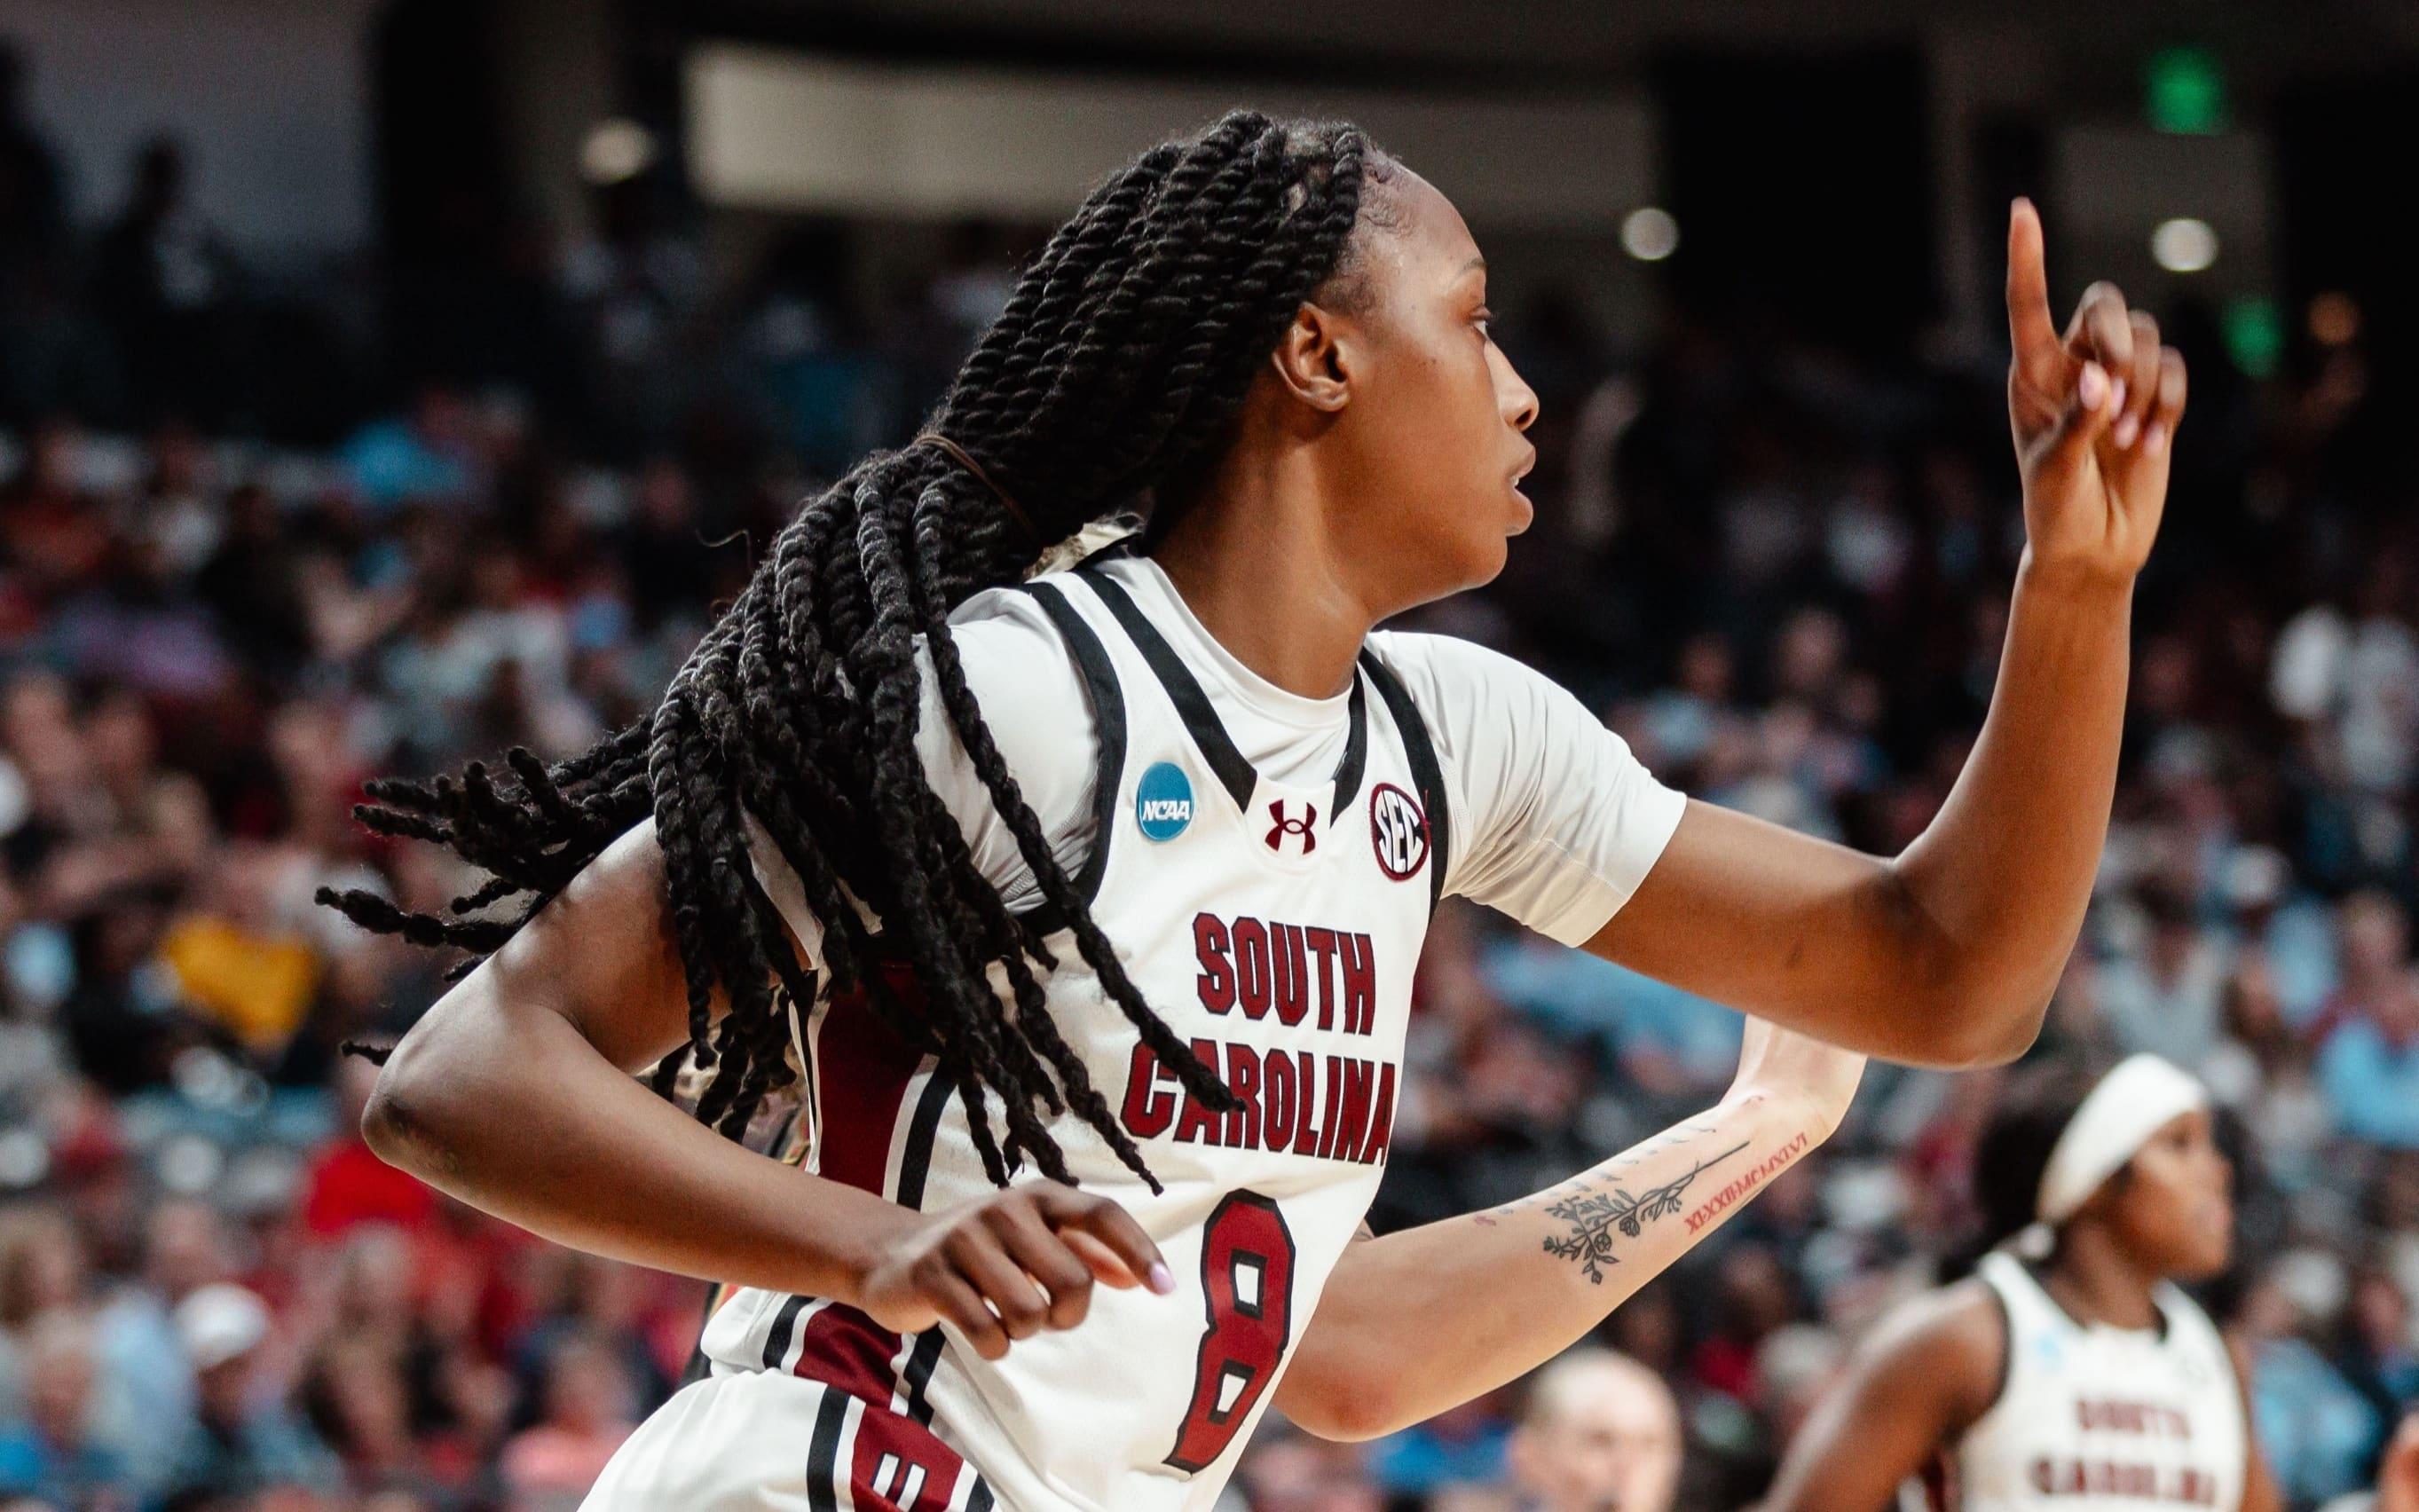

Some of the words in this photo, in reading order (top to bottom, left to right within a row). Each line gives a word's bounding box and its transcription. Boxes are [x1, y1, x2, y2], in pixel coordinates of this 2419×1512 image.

[1142, 800, 1191, 821] NCAA
[1378, 788, 1425, 874] SEC
[1192, 911, 1375, 1036] SOUTH
[1120, 1037, 1396, 1167] CAROLINA
[1161, 1188, 1296, 1475] 8
